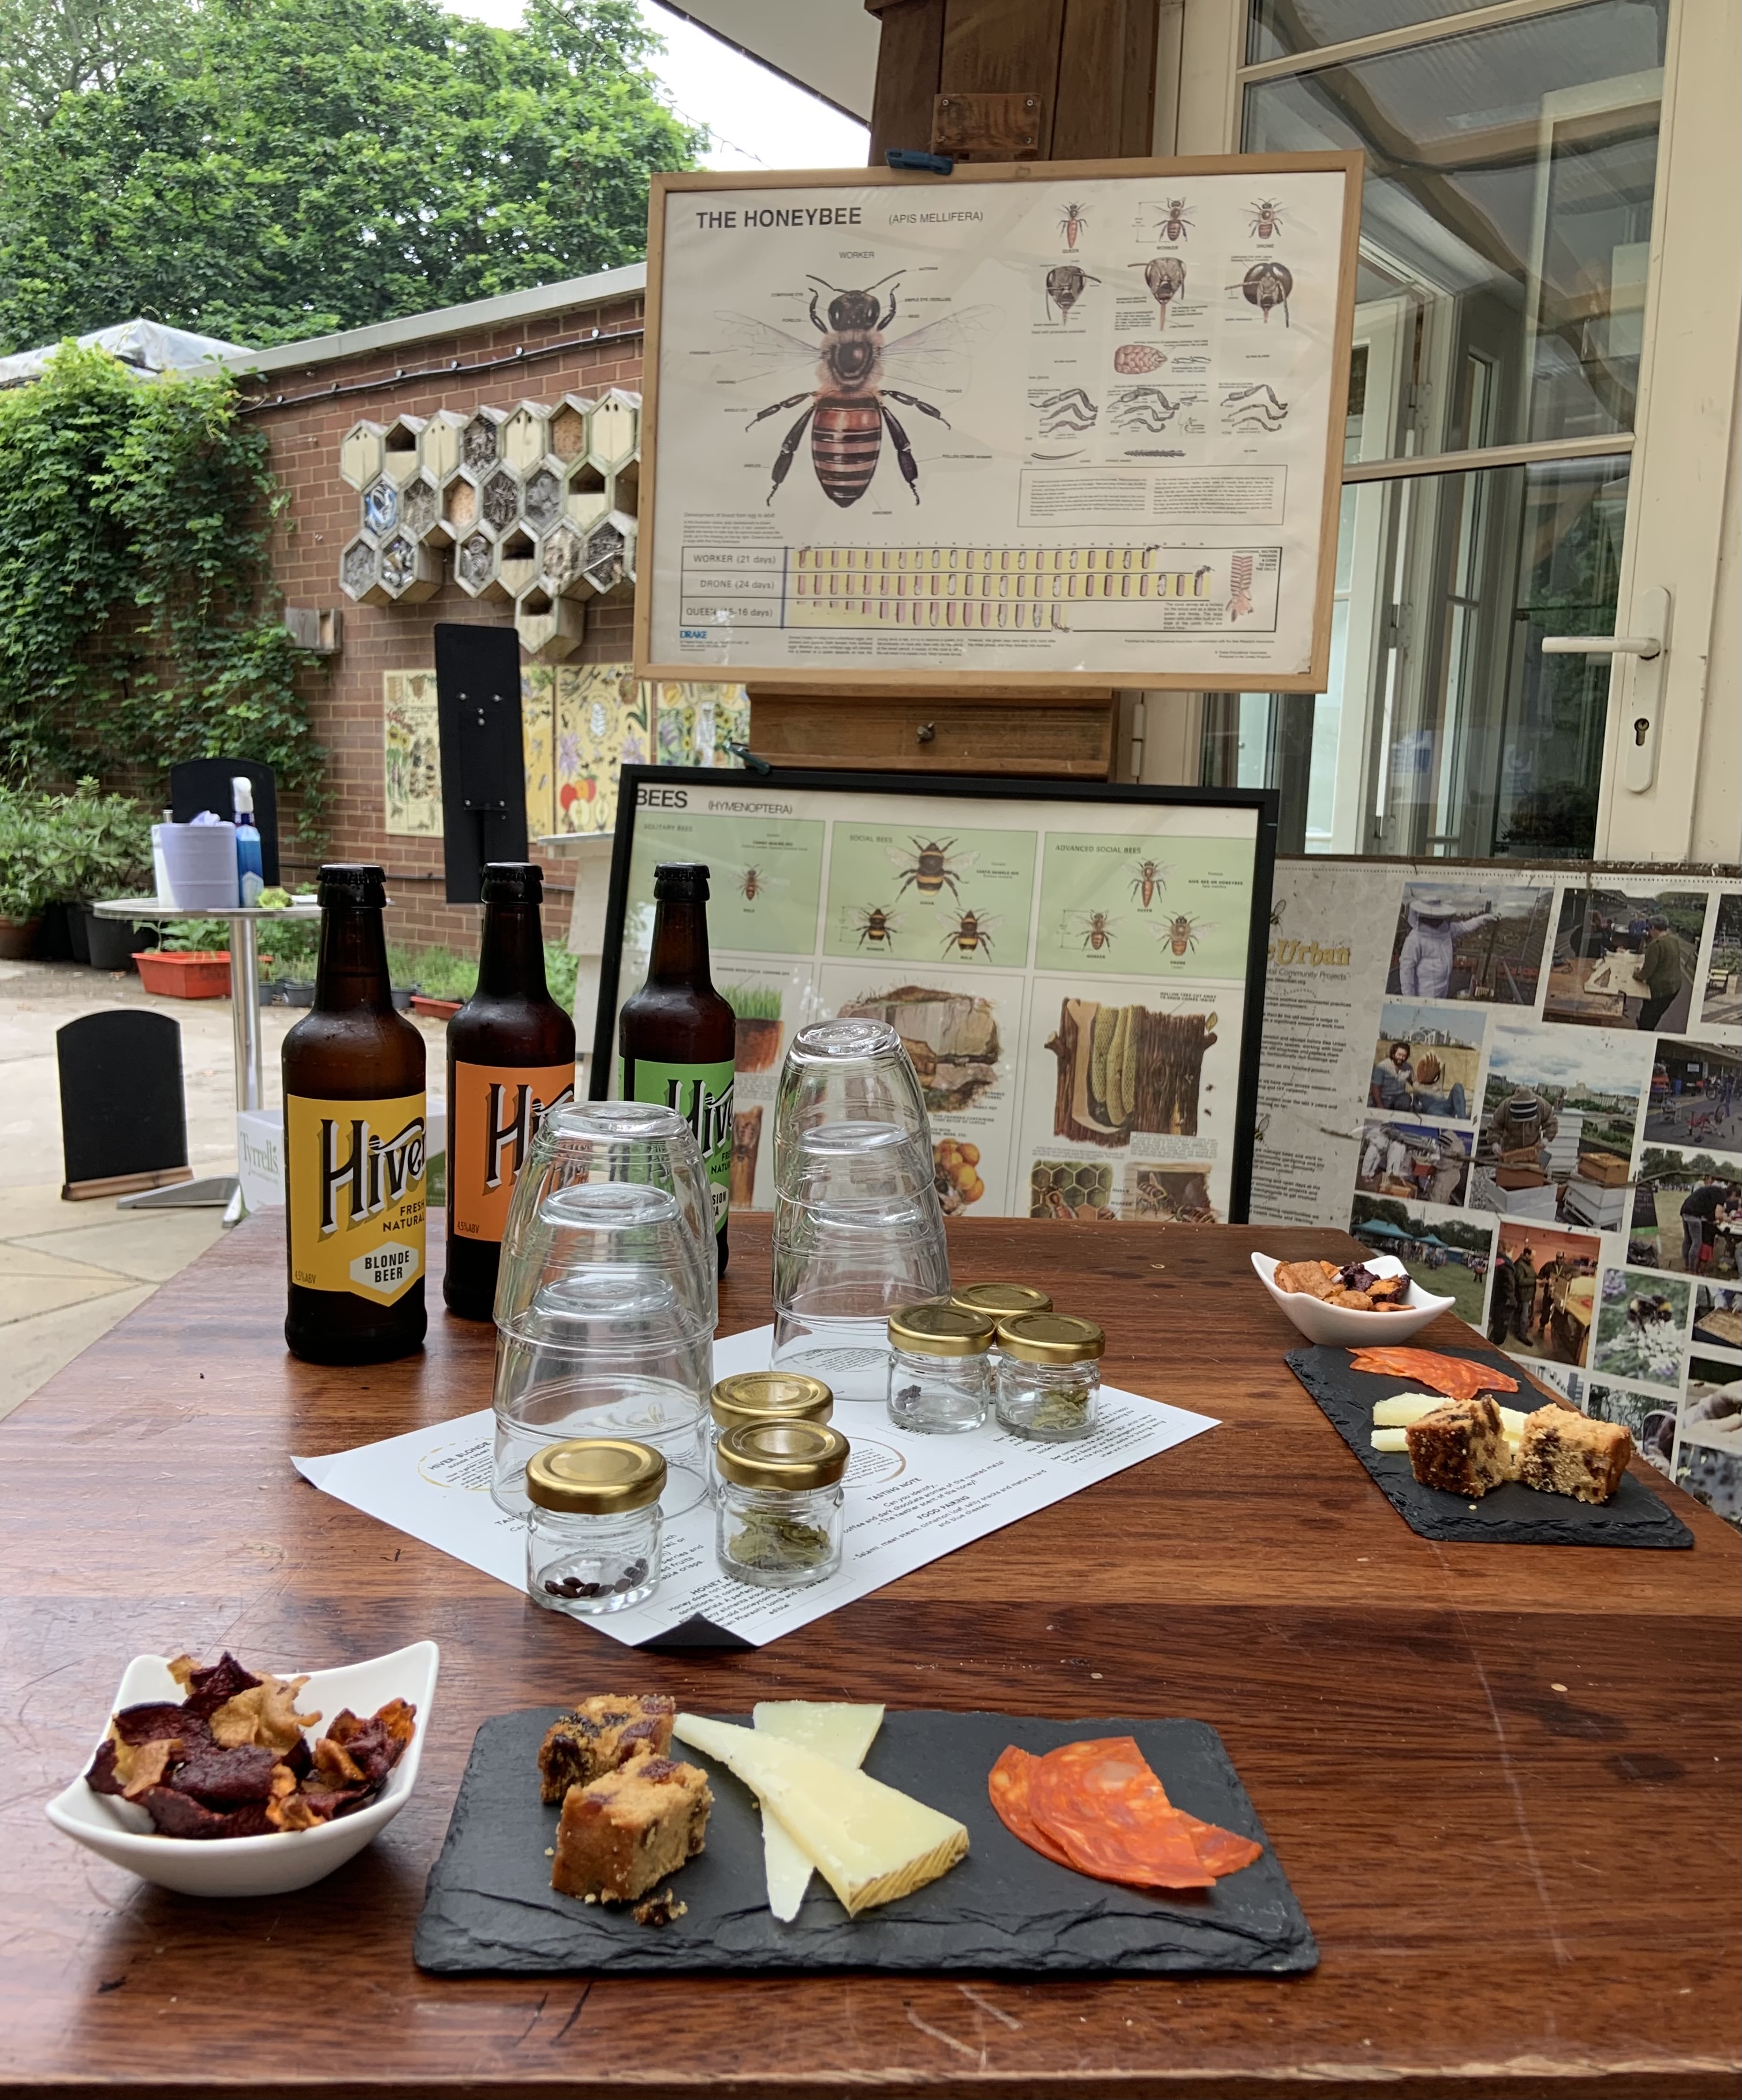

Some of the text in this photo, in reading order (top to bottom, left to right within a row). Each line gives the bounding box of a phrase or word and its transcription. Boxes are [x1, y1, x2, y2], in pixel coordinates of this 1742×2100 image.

[696, 207, 983, 229] THE HONEYBEE (APIS MELLIFERA)
[839, 251, 875, 259] WORKER
[693, 555, 776, 564] WORKER (21 days)
[735, 580, 749, 589] (24
[752, 580, 774, 590] days)
[751, 609, 773, 617] days)
[680, 631, 707, 639] DRAKE
[636, 789, 793, 815] BEES (HYMENOPTERA)
[677, 824, 693, 833] BEES
[849, 834, 893, 844] SOCIAL BEES
[1055, 845, 1095, 853] ADVANCED
[1279, 968, 1346, 981] Community Projects
[364, 1250, 410, 1270] BLONDE
[375, 1266, 403, 1283] BEER
[427, 1441, 491, 1470] HIVER BLONDE
[866, 1478, 922, 1501] TASTING NOTE
[842, 1523, 866, 1533] coffee
[893, 1497, 924, 1510] chocolate
[924, 1487, 946, 1497] aromas
[964, 1468, 987, 1479] roasted
[893, 1505, 919, 1517] heather
[920, 1498, 938, 1506] scent
[916, 1495, 970, 1519] FOOD PAIRING
[855, 1546, 882, 1558] Salami,
[881, 1537, 900, 1546] meat
[898, 1528, 922, 1538] stews,
[920, 1513, 952, 1528] cinnamon
[980, 1491, 1001, 1501] snacks
[670, 1557, 694, 1567] fruits
[679, 1561, 704, 1571] crisps.
[689, 1579, 722, 1595] HONEY
[731, 1587, 756, 1600] perfect
[667, 1601, 691, 1612] Honey
[678, 1599, 715, 1615] conditions.
[720, 1587, 771, 1612] ailments around
[738, 1594, 777, 1611] honeycomb
[734, 1606, 767, 1621] Pharaoh's
[766, 1598, 785, 1606] tomb
